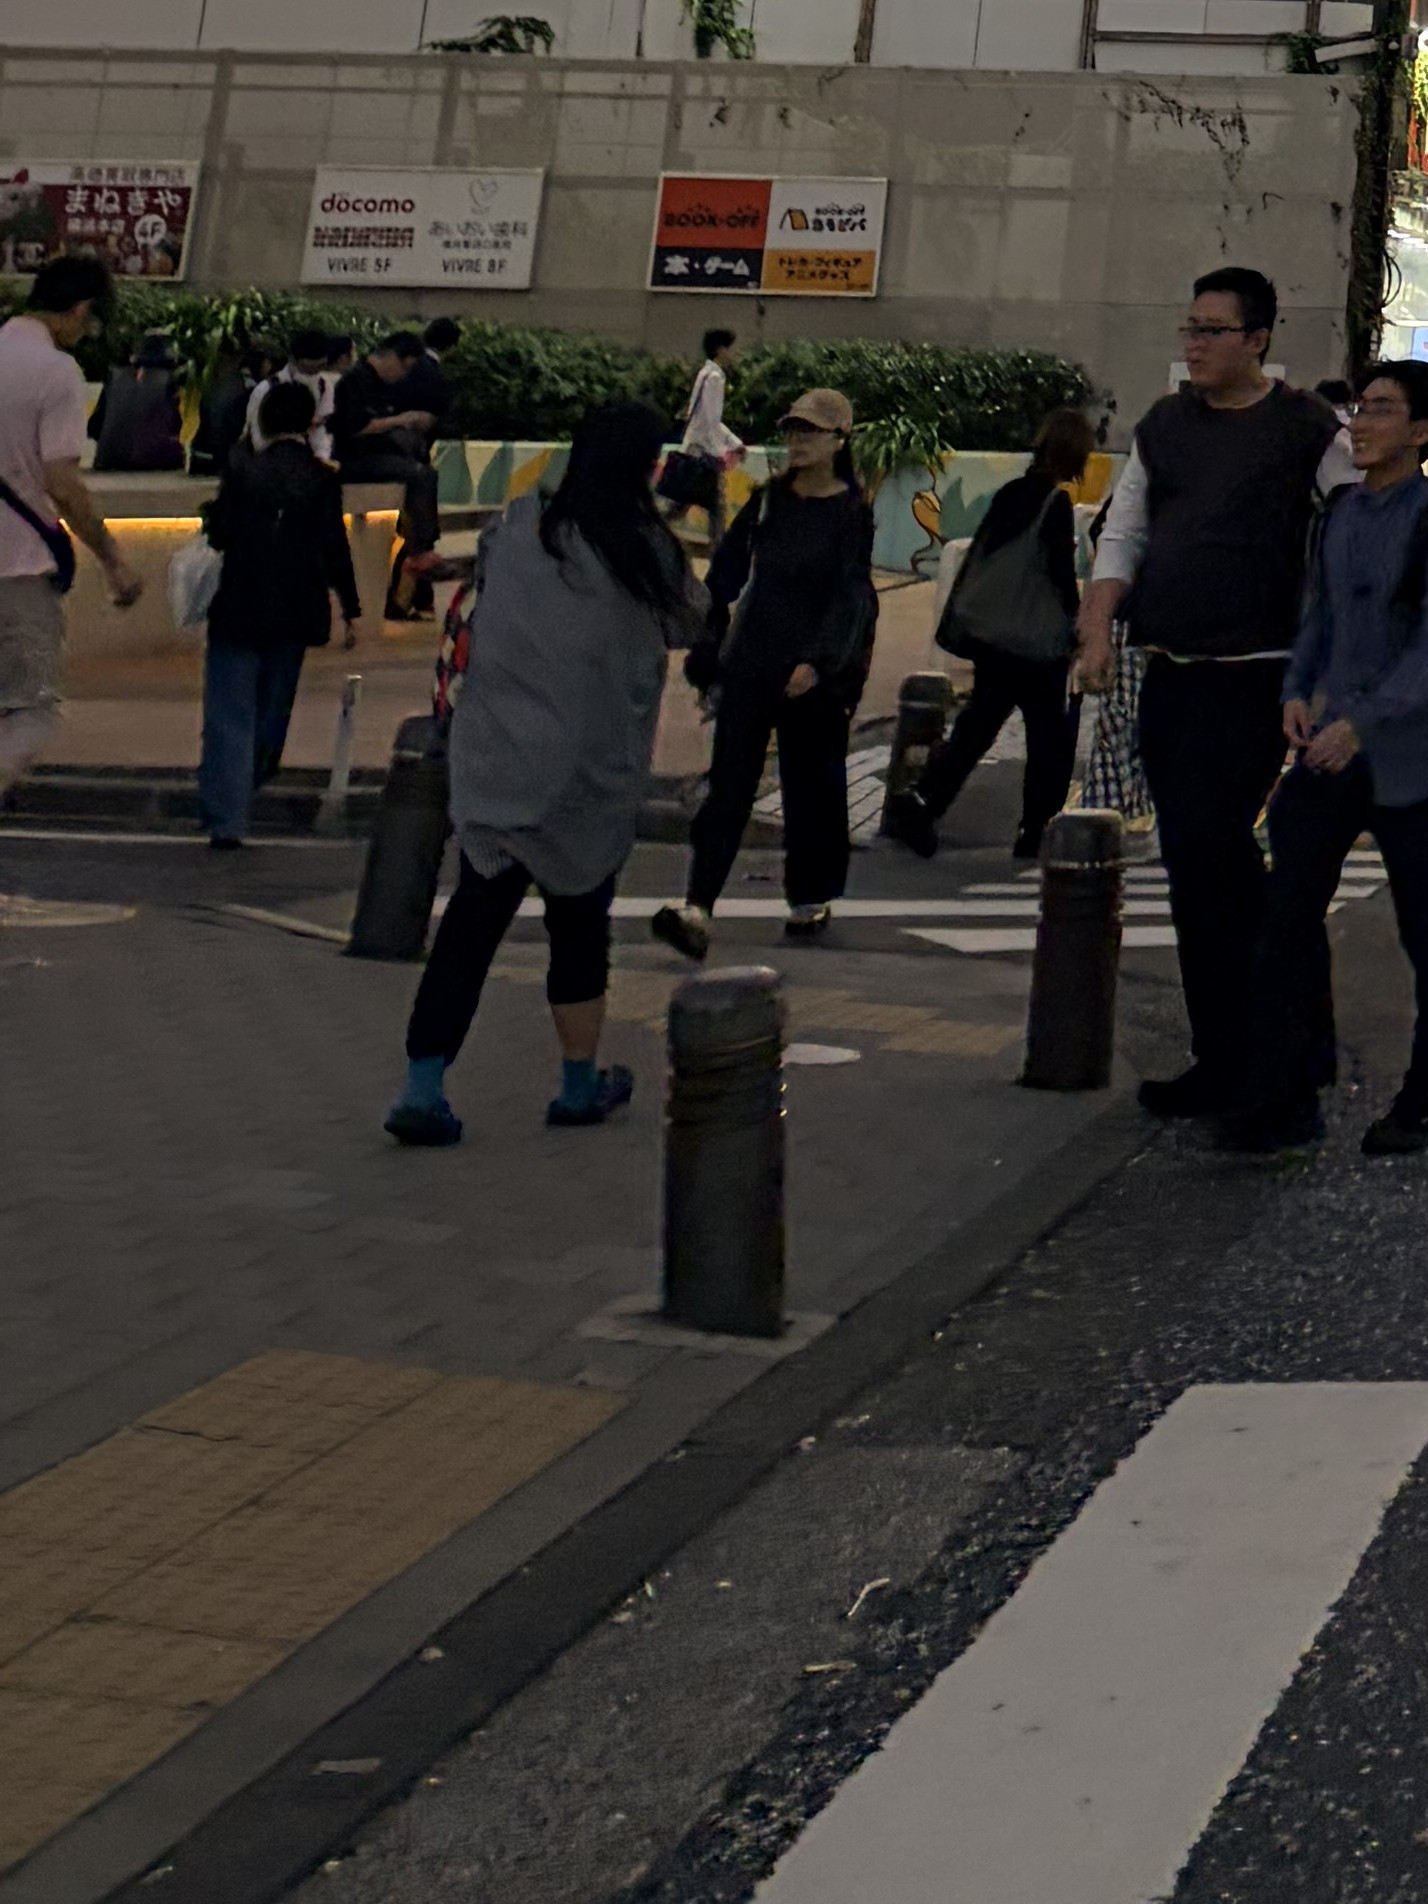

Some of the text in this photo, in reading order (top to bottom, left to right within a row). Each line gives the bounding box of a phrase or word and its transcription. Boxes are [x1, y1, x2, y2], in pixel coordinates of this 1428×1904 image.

[321, 193, 416, 213] docomo
[328, 257, 368, 272] VIVRE
[442, 258, 482, 273] VIVRE
